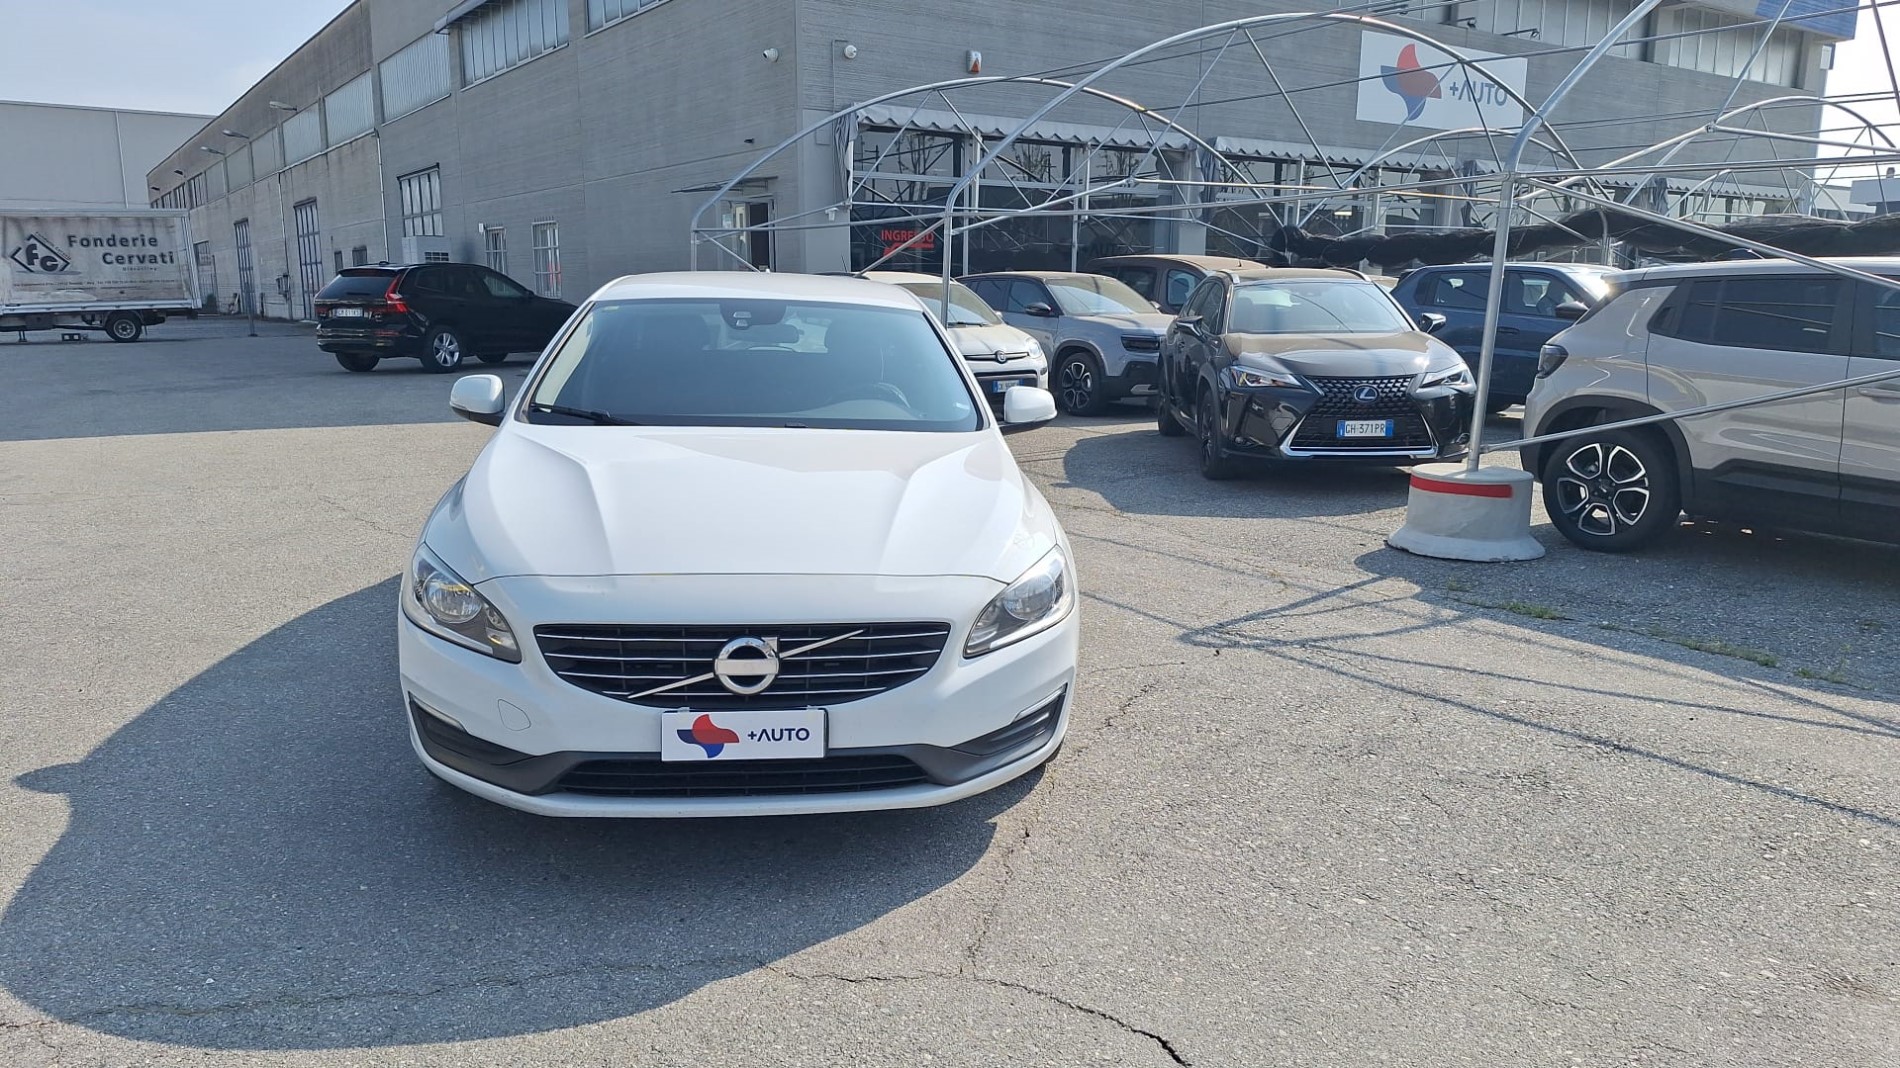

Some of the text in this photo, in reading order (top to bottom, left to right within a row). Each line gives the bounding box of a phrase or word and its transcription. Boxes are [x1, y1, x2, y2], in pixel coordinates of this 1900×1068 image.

[66, 234, 158, 248] Fonderie
[881, 230, 934, 242] INGREO
[102, 251, 175, 265] Cervati
[747, 727, 810, 742] +AUTO
